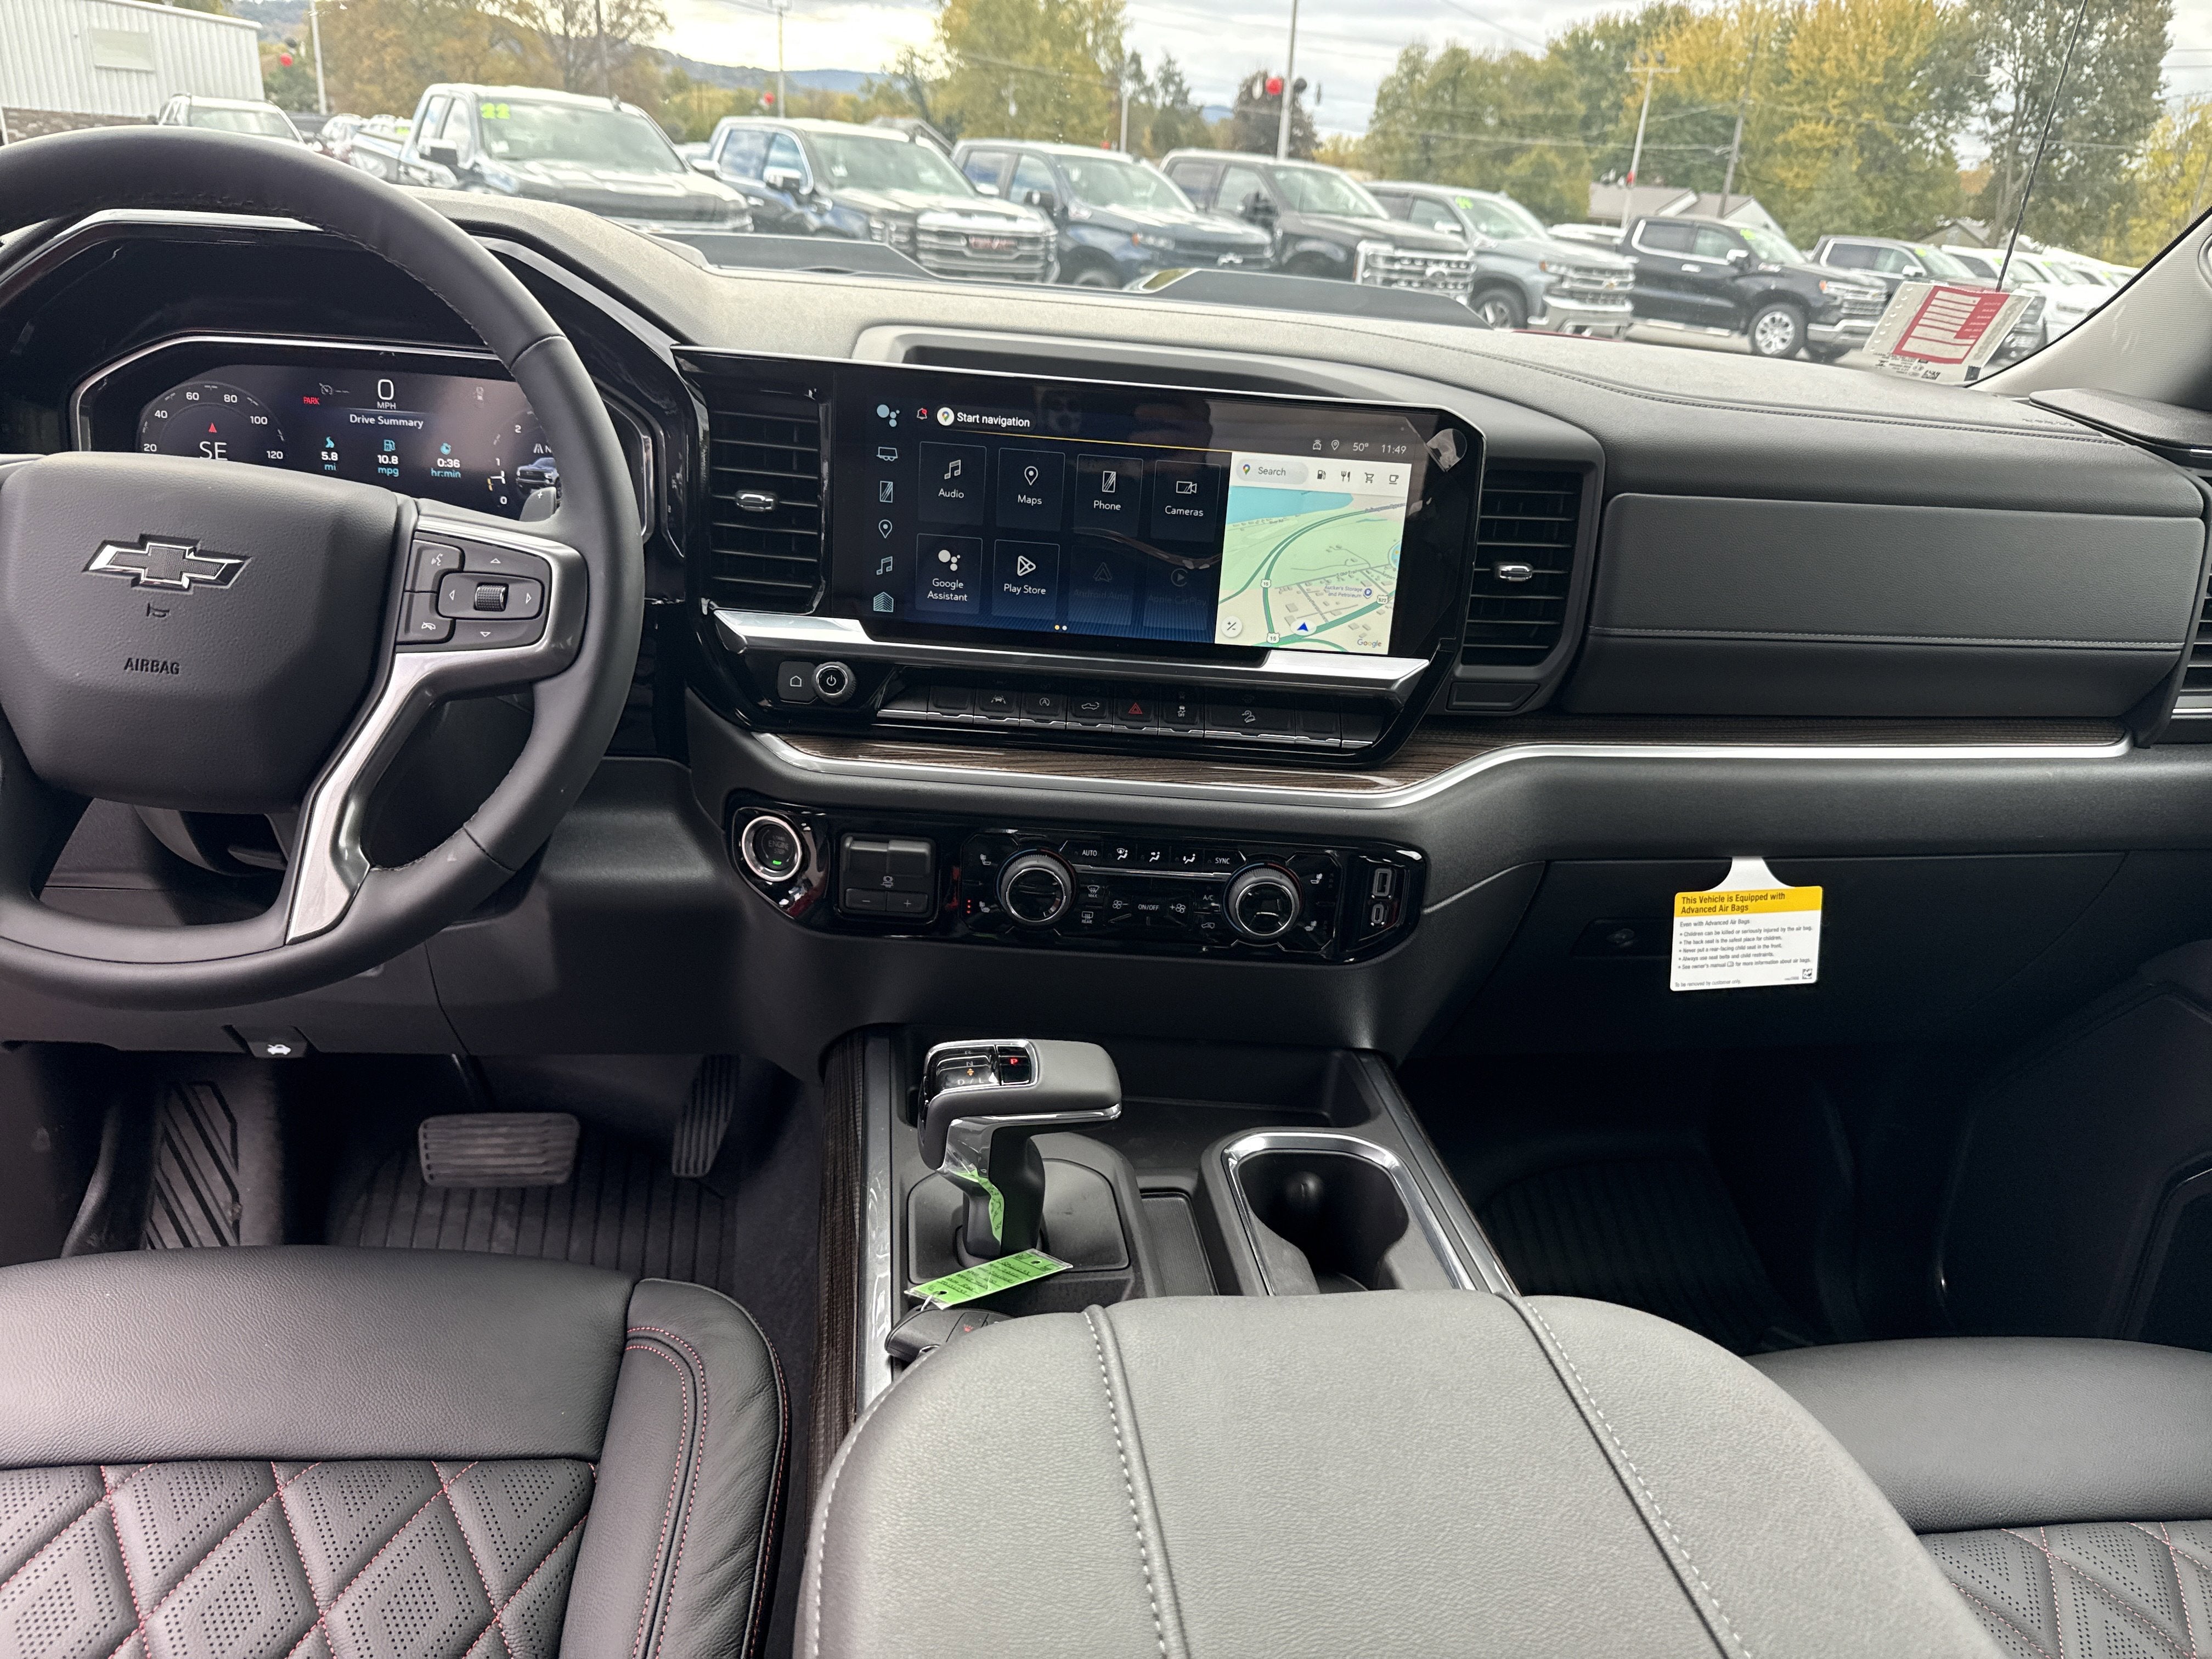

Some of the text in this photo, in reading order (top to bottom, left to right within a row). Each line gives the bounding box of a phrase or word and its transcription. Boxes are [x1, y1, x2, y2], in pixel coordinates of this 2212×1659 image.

[480, 102, 510, 119] 22
[378, 379, 394, 400] 0
[224, 394, 238, 403] 80
[303, 396, 320, 405] PARK
[377, 402, 396, 410] MPH
[154, 410, 168, 419] 40
[250, 416, 268, 425] 100
[349, 414, 424, 429] Drive Summary
[957, 412, 1030, 428] Start navigation
[515, 425, 521, 433] 2
[144, 444, 157, 452] 20
[199, 441, 228, 461] SE
[1353, 442, 1368, 452] 50°
[1381, 444, 1406, 454] 11:49
[267, 450, 283, 459] 120
[321, 452, 338, 461] 5.8
[377, 455, 398, 464] 10.8
[324, 462, 336, 471] mi
[437, 458, 460, 467] 0:36
[496, 458, 500, 466] 1
[377, 467, 399, 477] mpg
[1258, 466, 1286, 476] Search
[938, 488, 964, 499] Audio
[1018, 494, 1042, 506] Maps
[1093, 500, 1121, 511] Phone
[1165, 505, 1204, 517] Cameras
[933, 578, 964, 591] Google
[1003, 583, 1046, 596] Play Store
[927, 591, 968, 602] Assistant
[1357, 639, 1381, 647] Google
[123, 657, 180, 675] AIRBAG
[768, 840, 789, 850] ENGINE
[1699, 895, 1725, 904] Vehicle
[1735, 893, 1768, 902] Equipped
[1681, 904, 1749, 914] Advanced Air Bags
